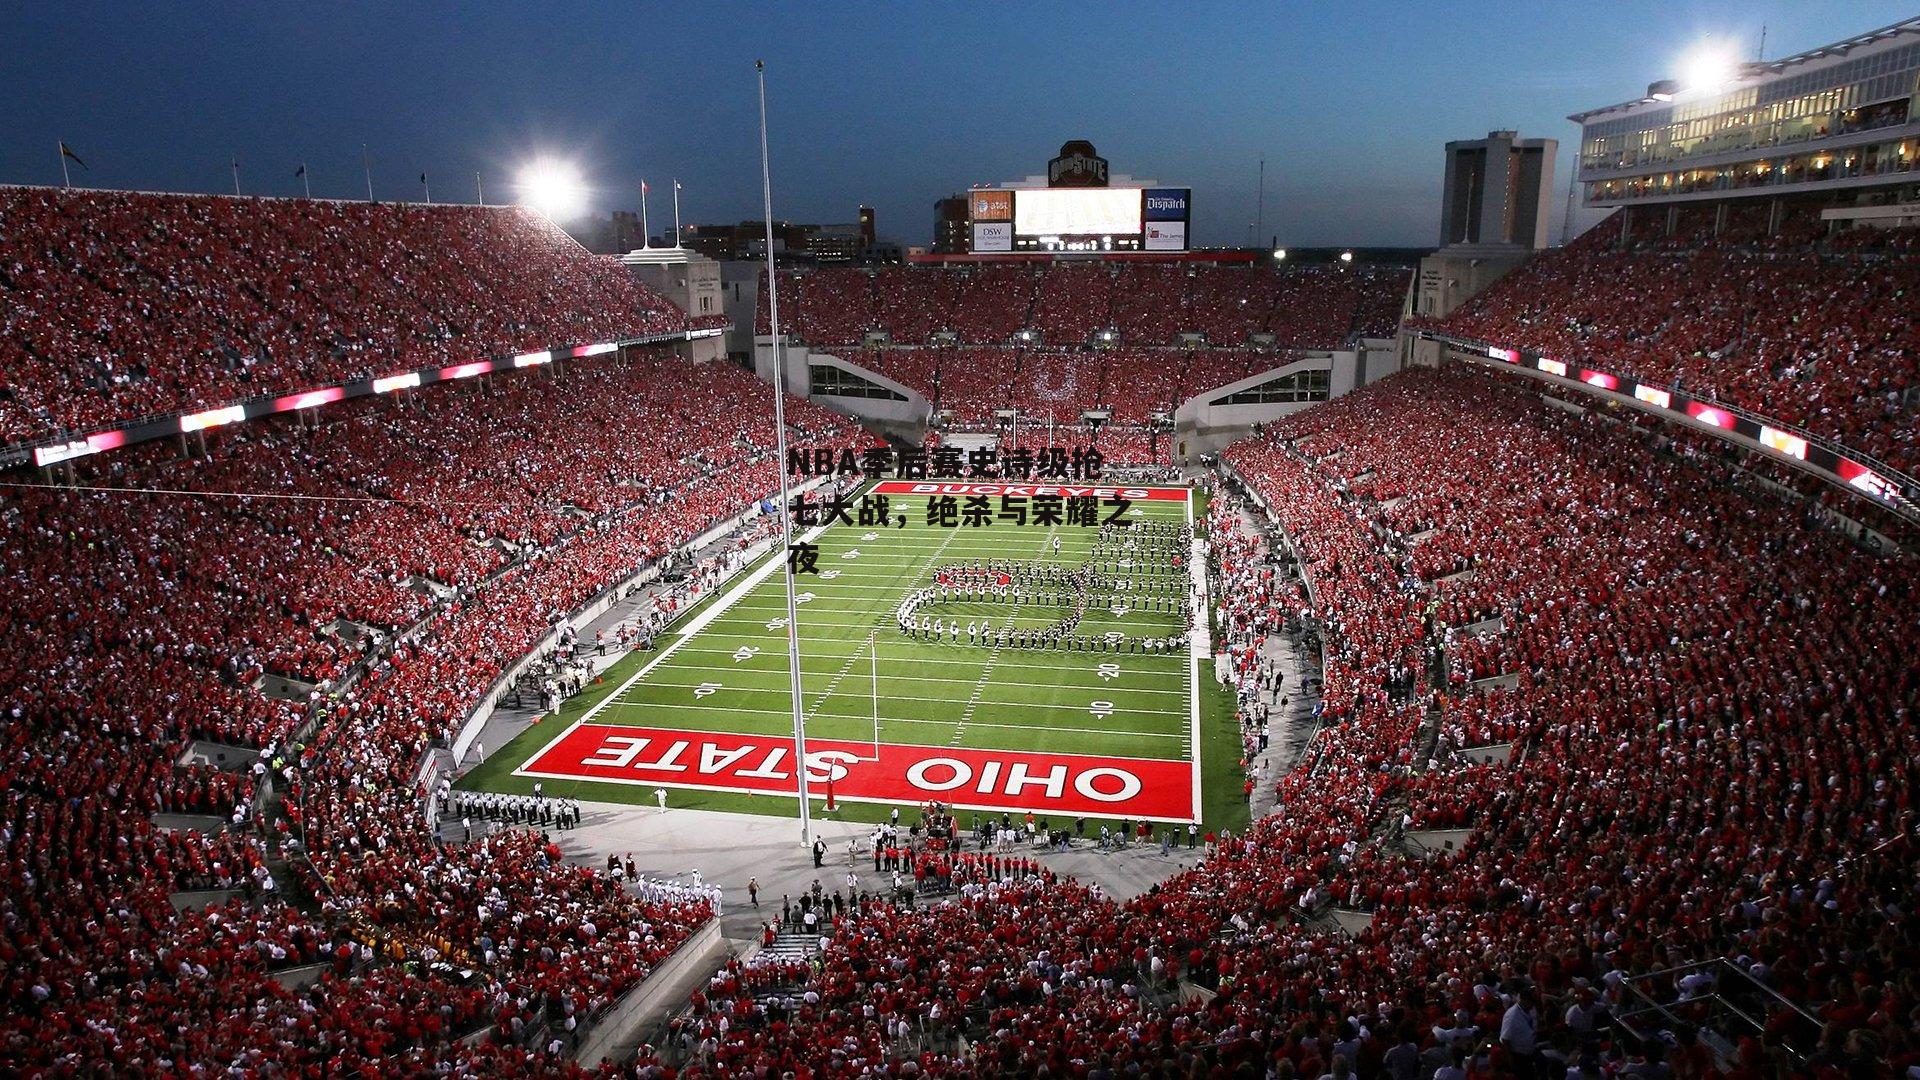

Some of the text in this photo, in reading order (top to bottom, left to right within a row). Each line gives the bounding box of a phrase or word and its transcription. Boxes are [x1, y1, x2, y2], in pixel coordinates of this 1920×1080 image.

[1147, 197, 1185, 211] Dispatch
[983, 228, 1002, 236] DSW
[911, 484, 1150, 498] BUCKEYES
[732, 646, 760, 659] 20
[1097, 663, 1120, 678] 20
[693, 682, 723, 695] 10
[1089, 701, 1114, 715] 10
[580, 736, 1142, 802] OHIO STATE
